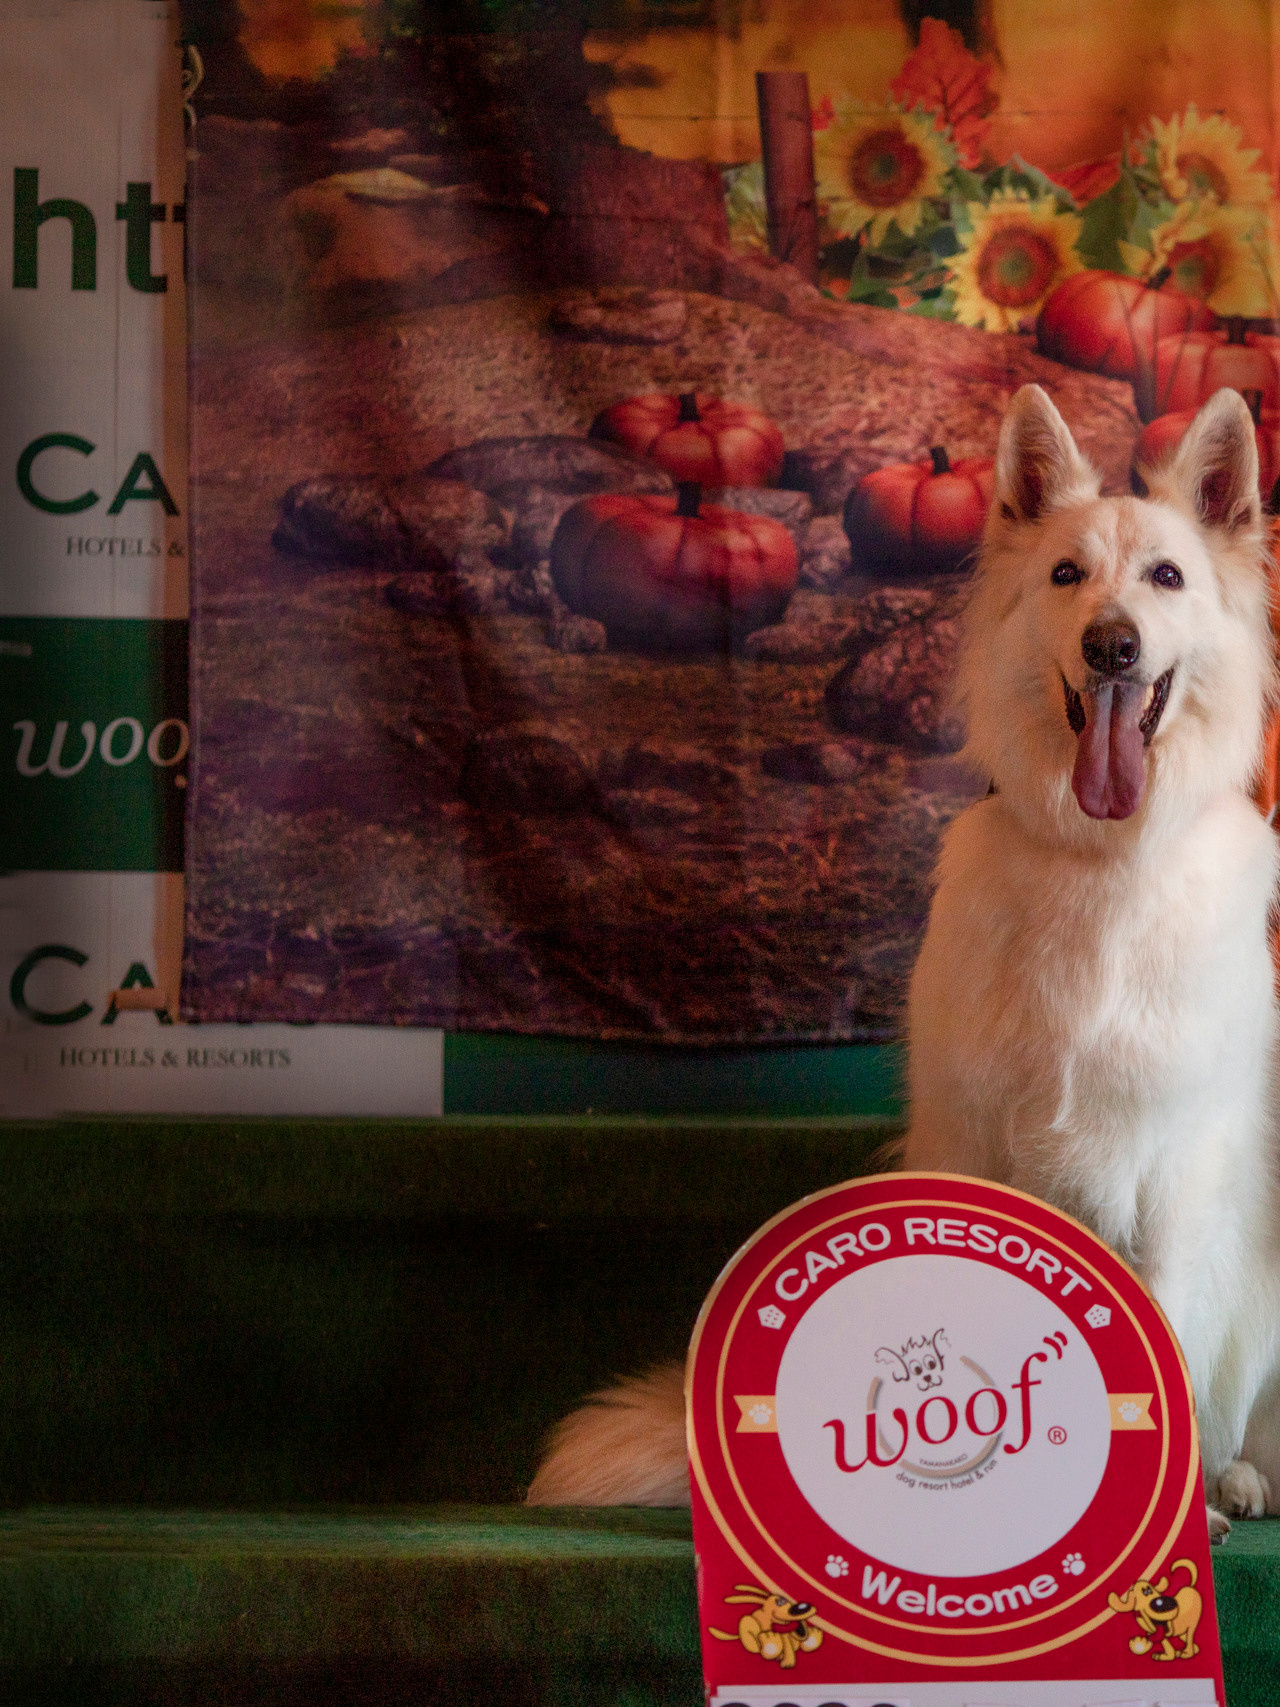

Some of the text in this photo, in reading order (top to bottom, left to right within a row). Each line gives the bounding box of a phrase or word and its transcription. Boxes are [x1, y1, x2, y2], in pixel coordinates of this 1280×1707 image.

[12, 167, 187, 293] ht
[66, 536, 185, 557] HOTELS &
[13, 716, 190, 790] woo
[60, 1047, 292, 1068] HOTELS & RESORTS
[775, 1217, 1092, 1301] CARO RESORT
[822, 1351, 1049, 1474] woof
[896, 1458, 998, 1492] dog resort hotel & run
[860, 1565, 1060, 1618] Welcome
